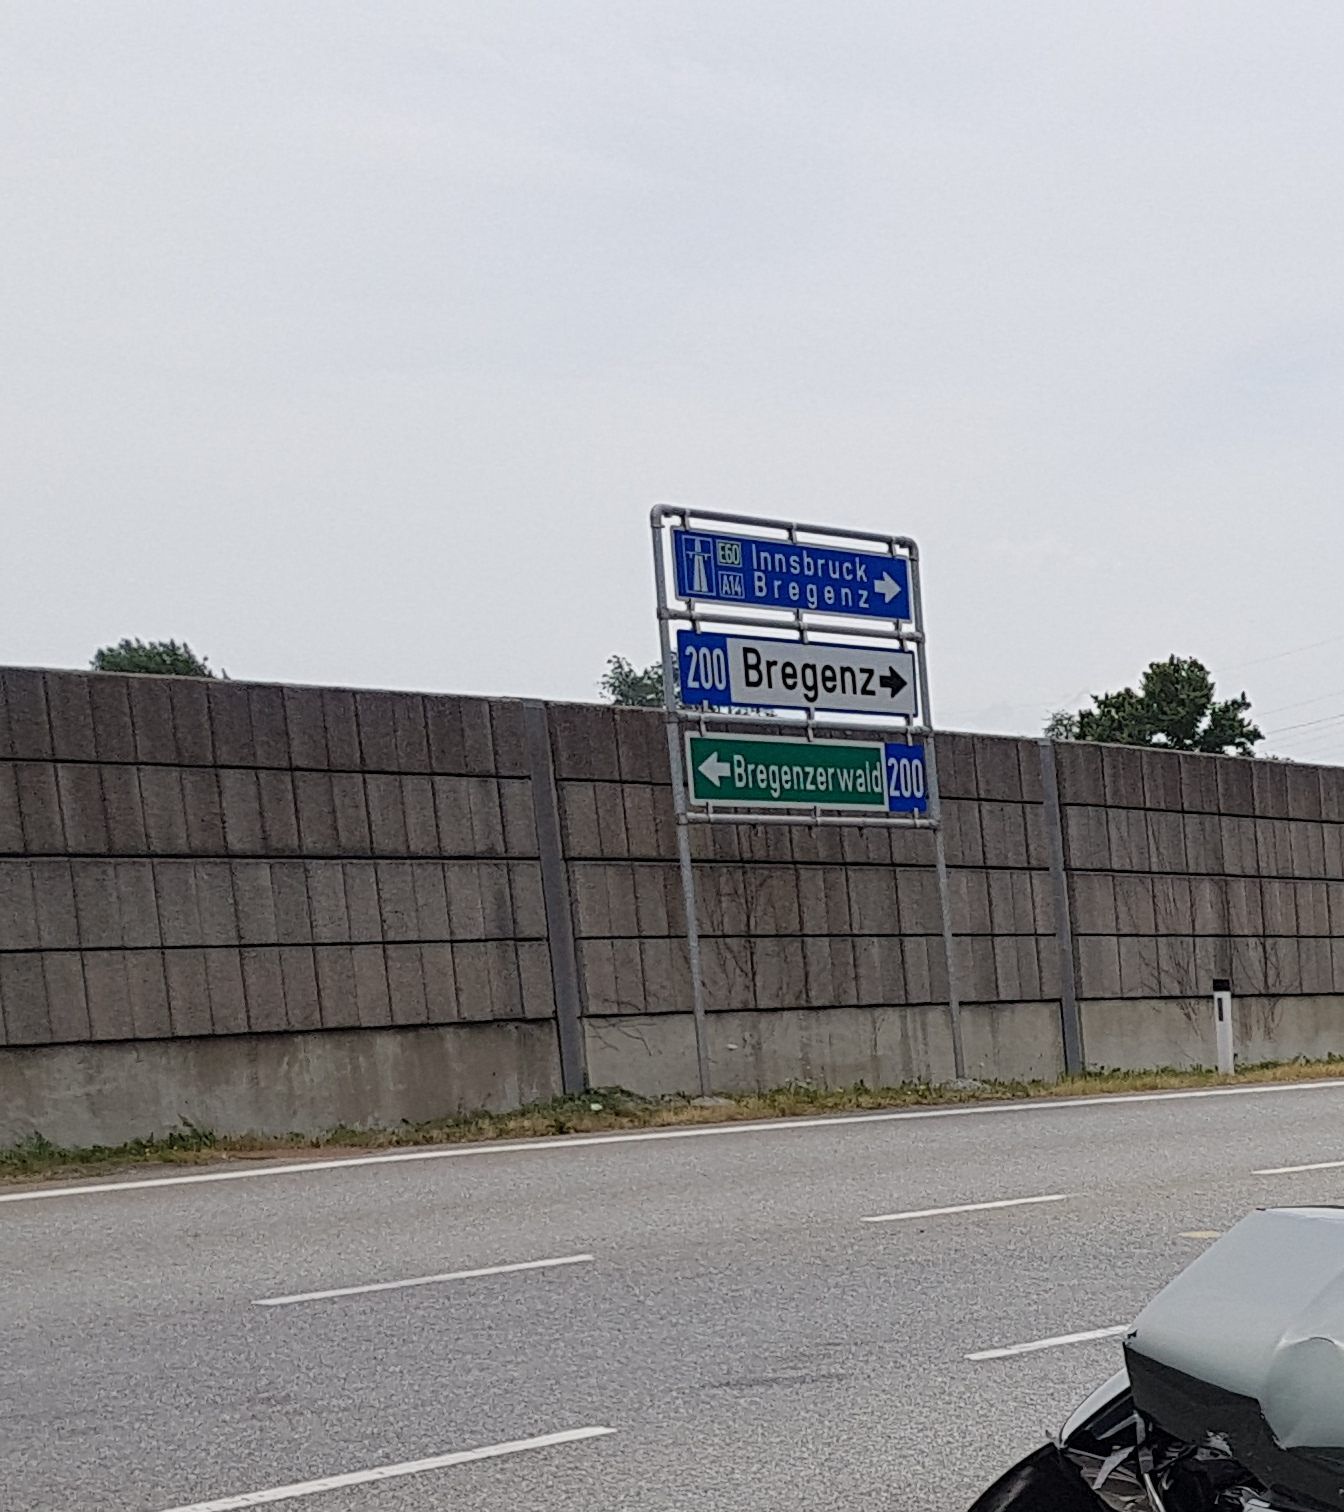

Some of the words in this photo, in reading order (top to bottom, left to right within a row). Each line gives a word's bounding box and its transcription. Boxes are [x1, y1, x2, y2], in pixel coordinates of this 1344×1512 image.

[717, 542, 741, 565] E60
[752, 543, 868, 582] Innsbruck
[721, 574, 743, 597] A14
[754, 571, 869, 609] Bregenz
[685, 646, 728, 690] 200
[742, 646, 877, 703] Bregenz
[733, 754, 883, 797] Bregenzerwald
[887, 758, 925, 798] 200
